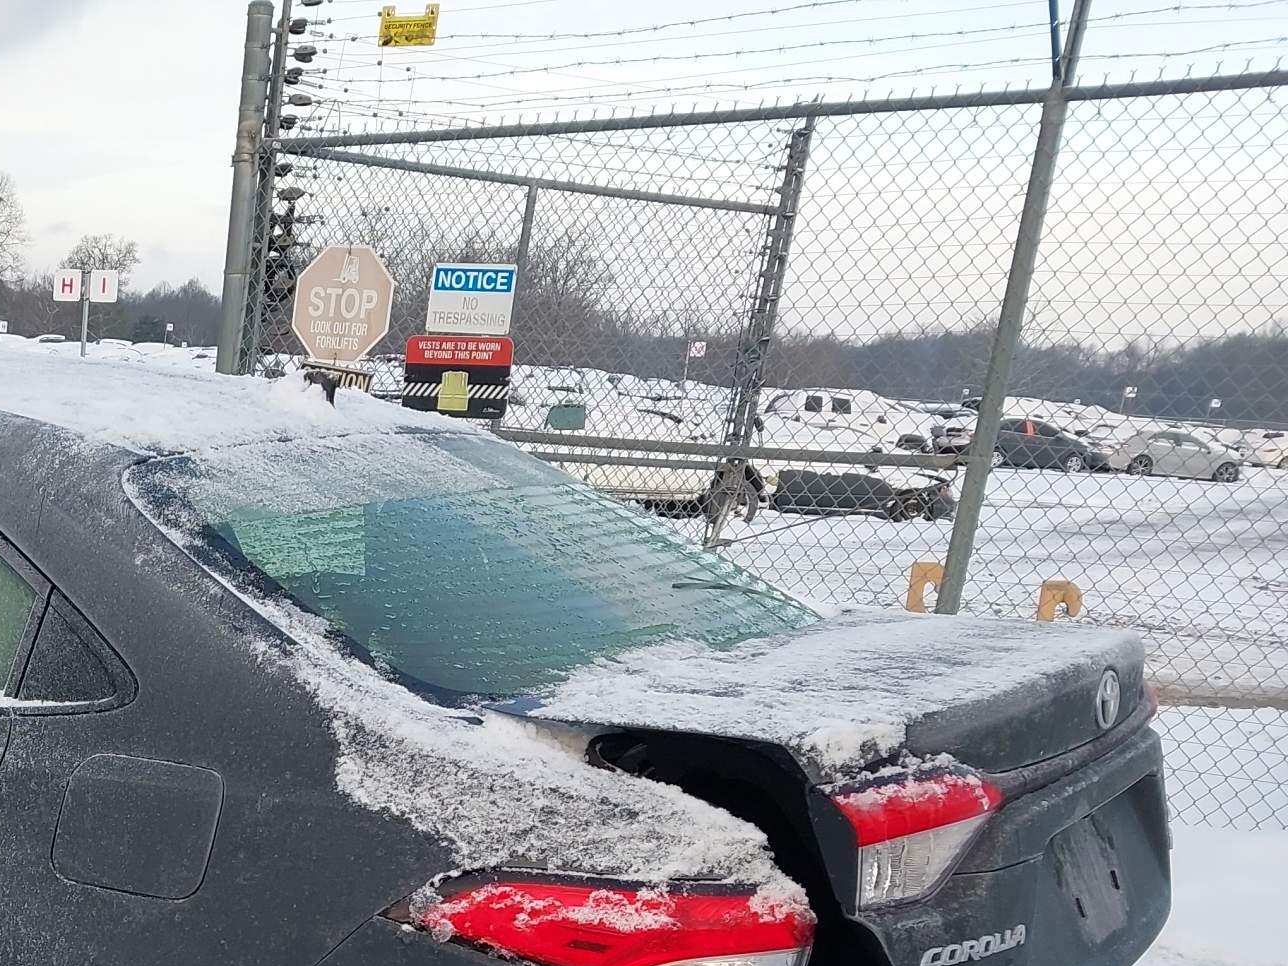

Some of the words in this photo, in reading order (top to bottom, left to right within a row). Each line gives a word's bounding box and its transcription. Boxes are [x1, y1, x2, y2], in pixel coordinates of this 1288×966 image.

[62, 278, 73, 294] H
[102, 277, 106, 294] I
[438, 271, 509, 290] NOTICE
[308, 286, 378, 319] STOP
[462, 296, 479, 310] NO
[432, 311, 505, 327] TRESPASSING
[310, 320, 331, 334] LOOK
[333, 321, 350, 335] OUT
[352, 321, 367, 336] FOR
[316, 337, 358, 351] FORKLIFTS
[418, 340, 440, 350] VESTS
[442, 341, 456, 350] ARE
[457, 342, 466, 350] TO
[468, 342, 477, 351] BE
[478, 342, 501, 351] WORN
[424, 350, 453, 359] BEYOND
[454, 351, 470, 359] THIS
[471, 351, 493, 360] POINT
